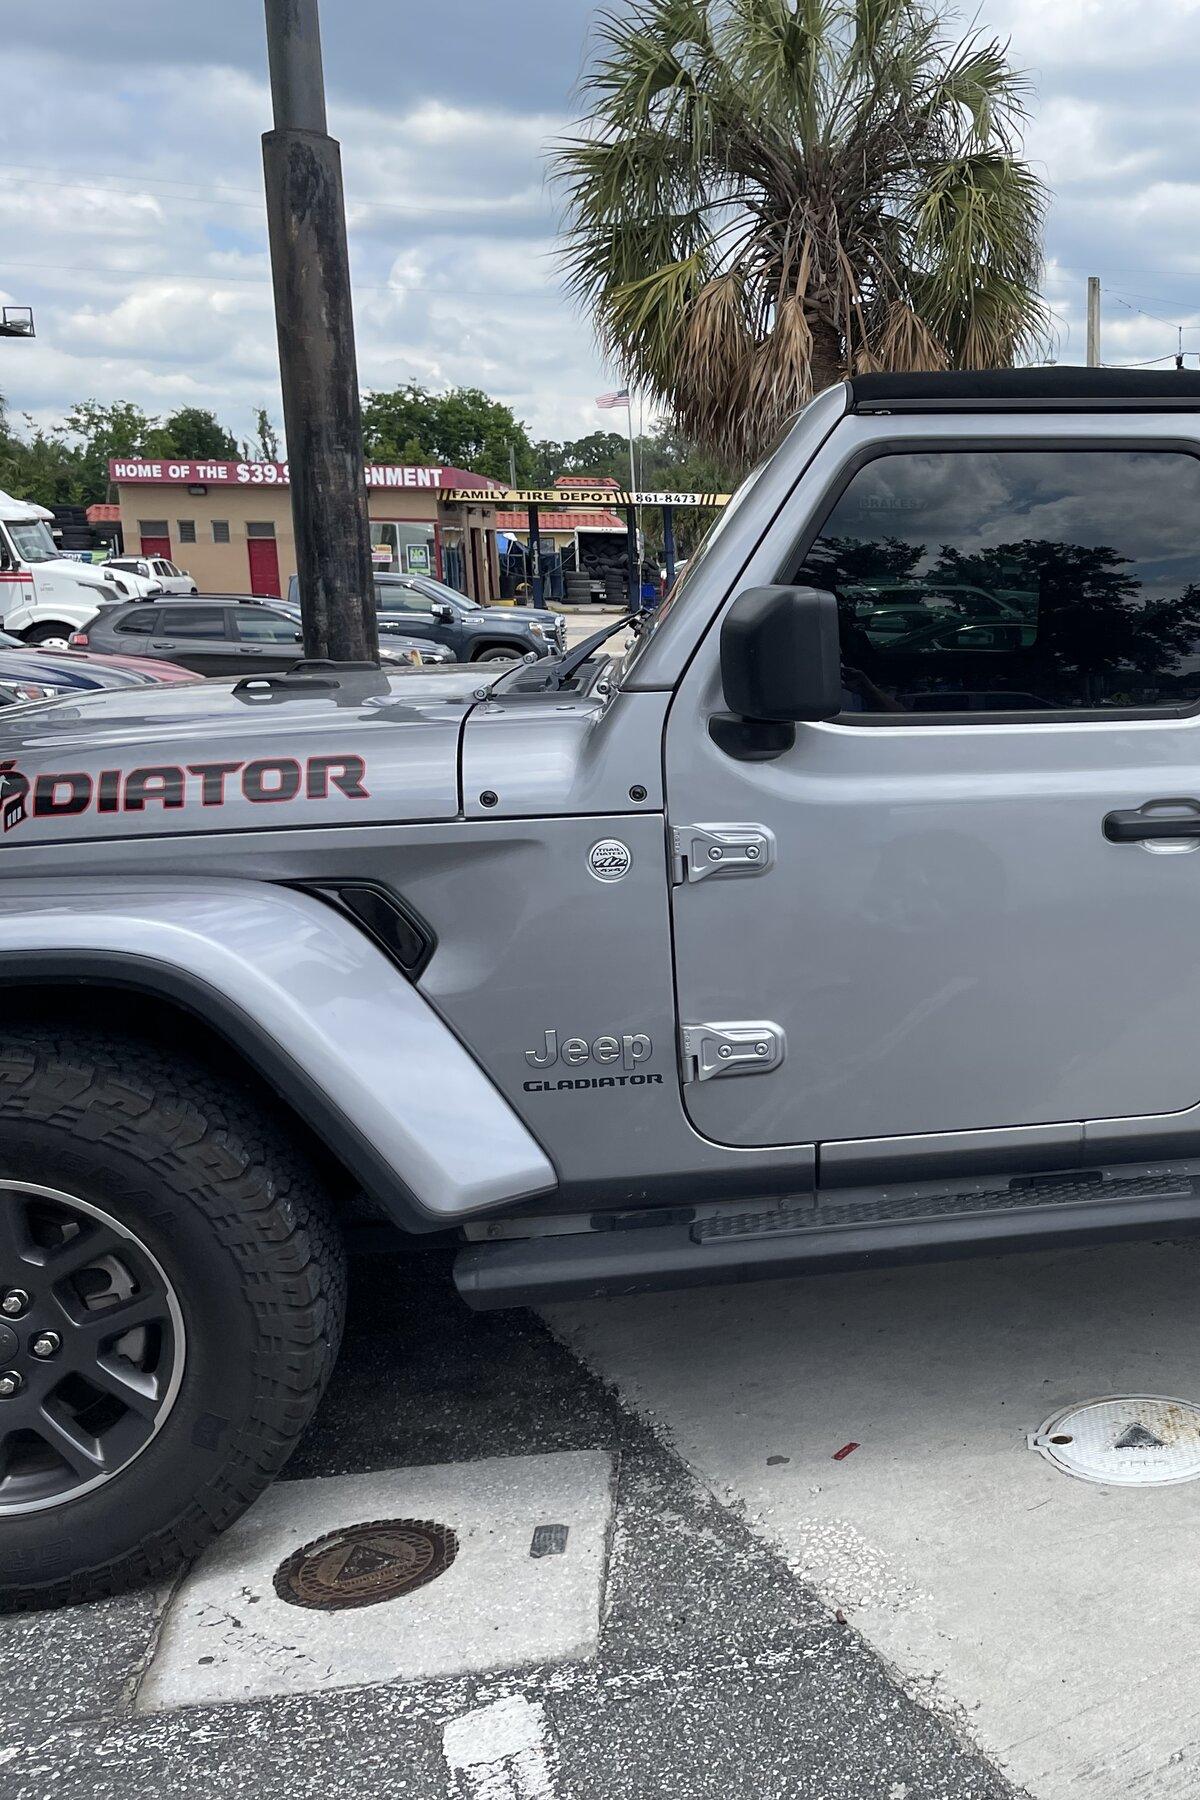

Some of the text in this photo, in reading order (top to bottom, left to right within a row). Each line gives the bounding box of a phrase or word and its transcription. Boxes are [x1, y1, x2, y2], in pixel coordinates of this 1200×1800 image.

[115, 464, 162, 477] HOME
[168, 465, 190, 478] OF
[196, 465, 228, 479] THE
[452, 490, 697, 503] FAMILY TIRE DEPOT 861-8473
[525, 1029, 653, 1071] Jeep
[523, 1073, 664, 1092] GLADIATOR
